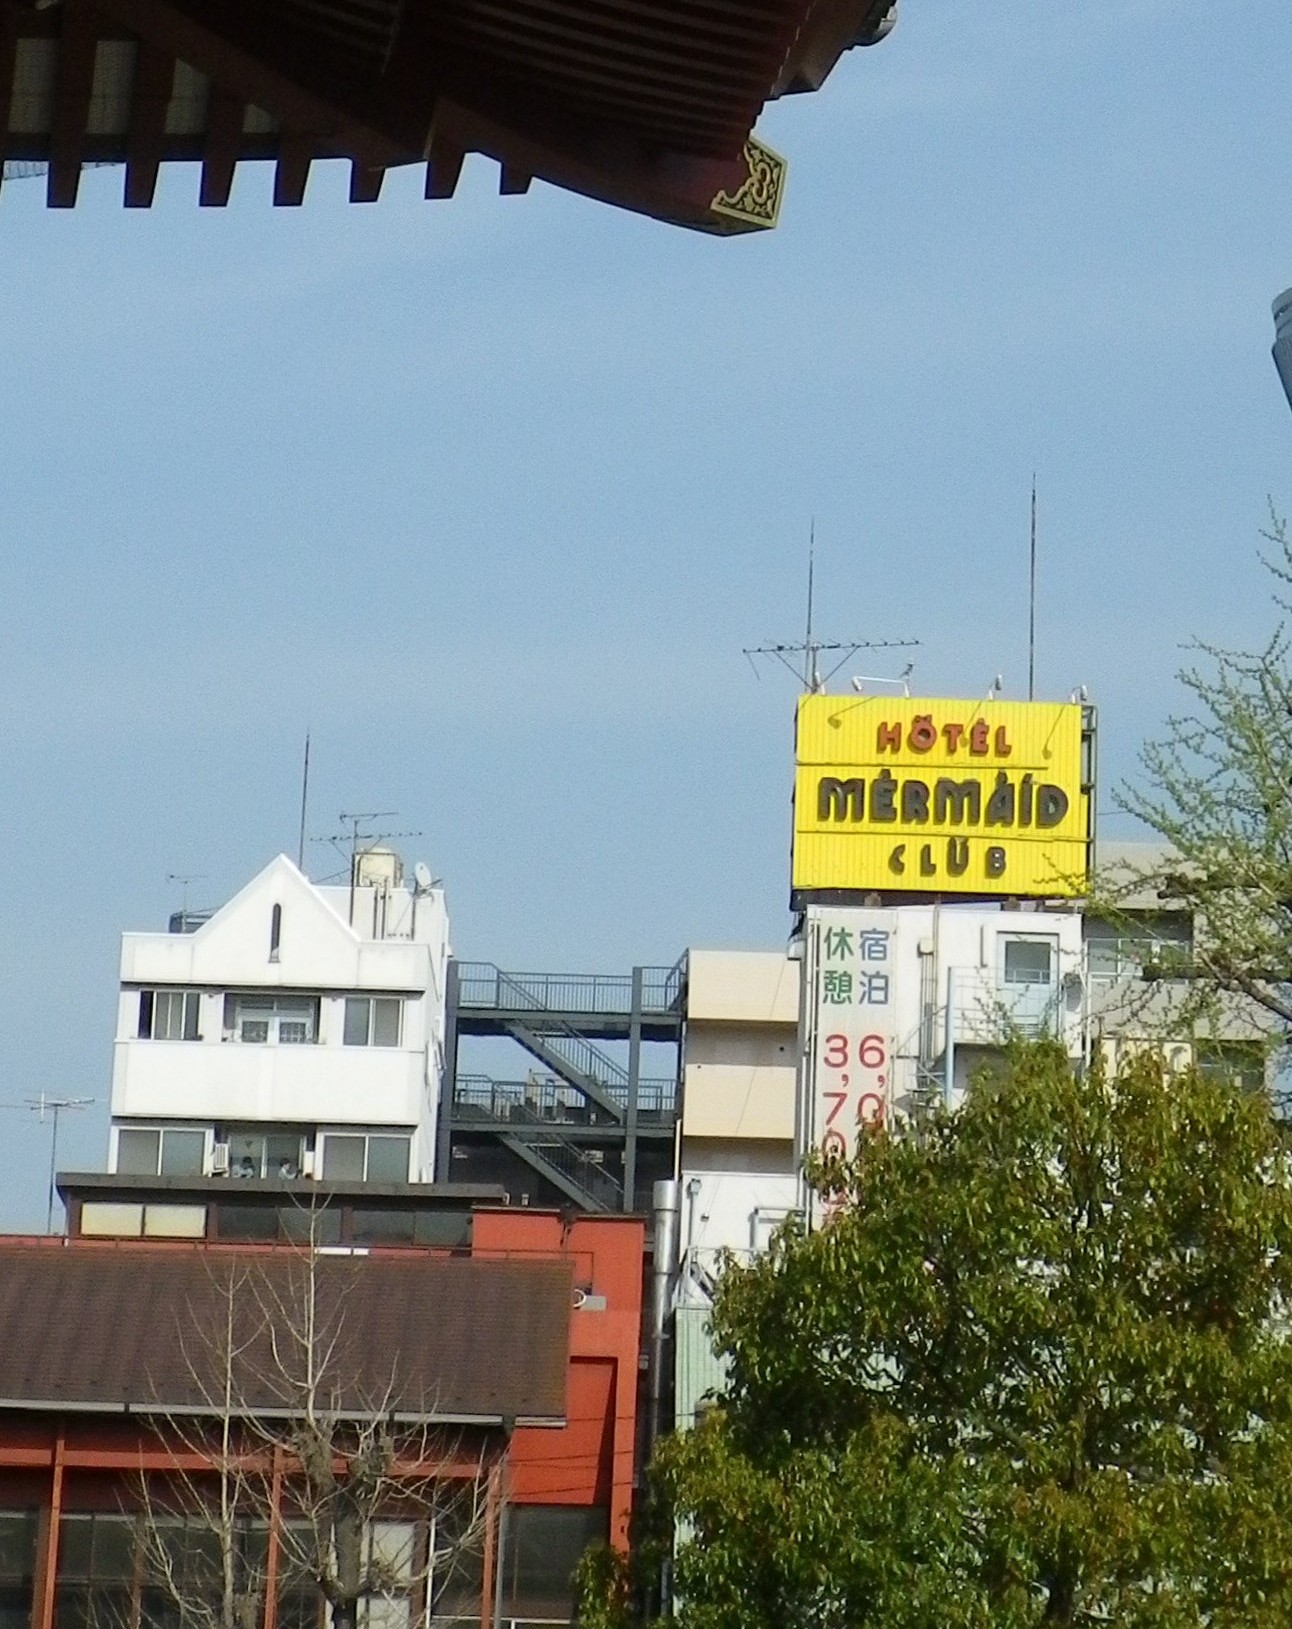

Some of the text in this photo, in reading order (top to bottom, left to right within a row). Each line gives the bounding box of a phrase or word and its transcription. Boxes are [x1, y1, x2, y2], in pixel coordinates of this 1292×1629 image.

[877, 715, 1012, 758] HOTEL
[817, 768, 1069, 829] MERMAID
[888, 837, 1007, 879] CLUB
[822, 926, 854, 1005] 休憩
[858, 927, 890, 1005] 宿泊
